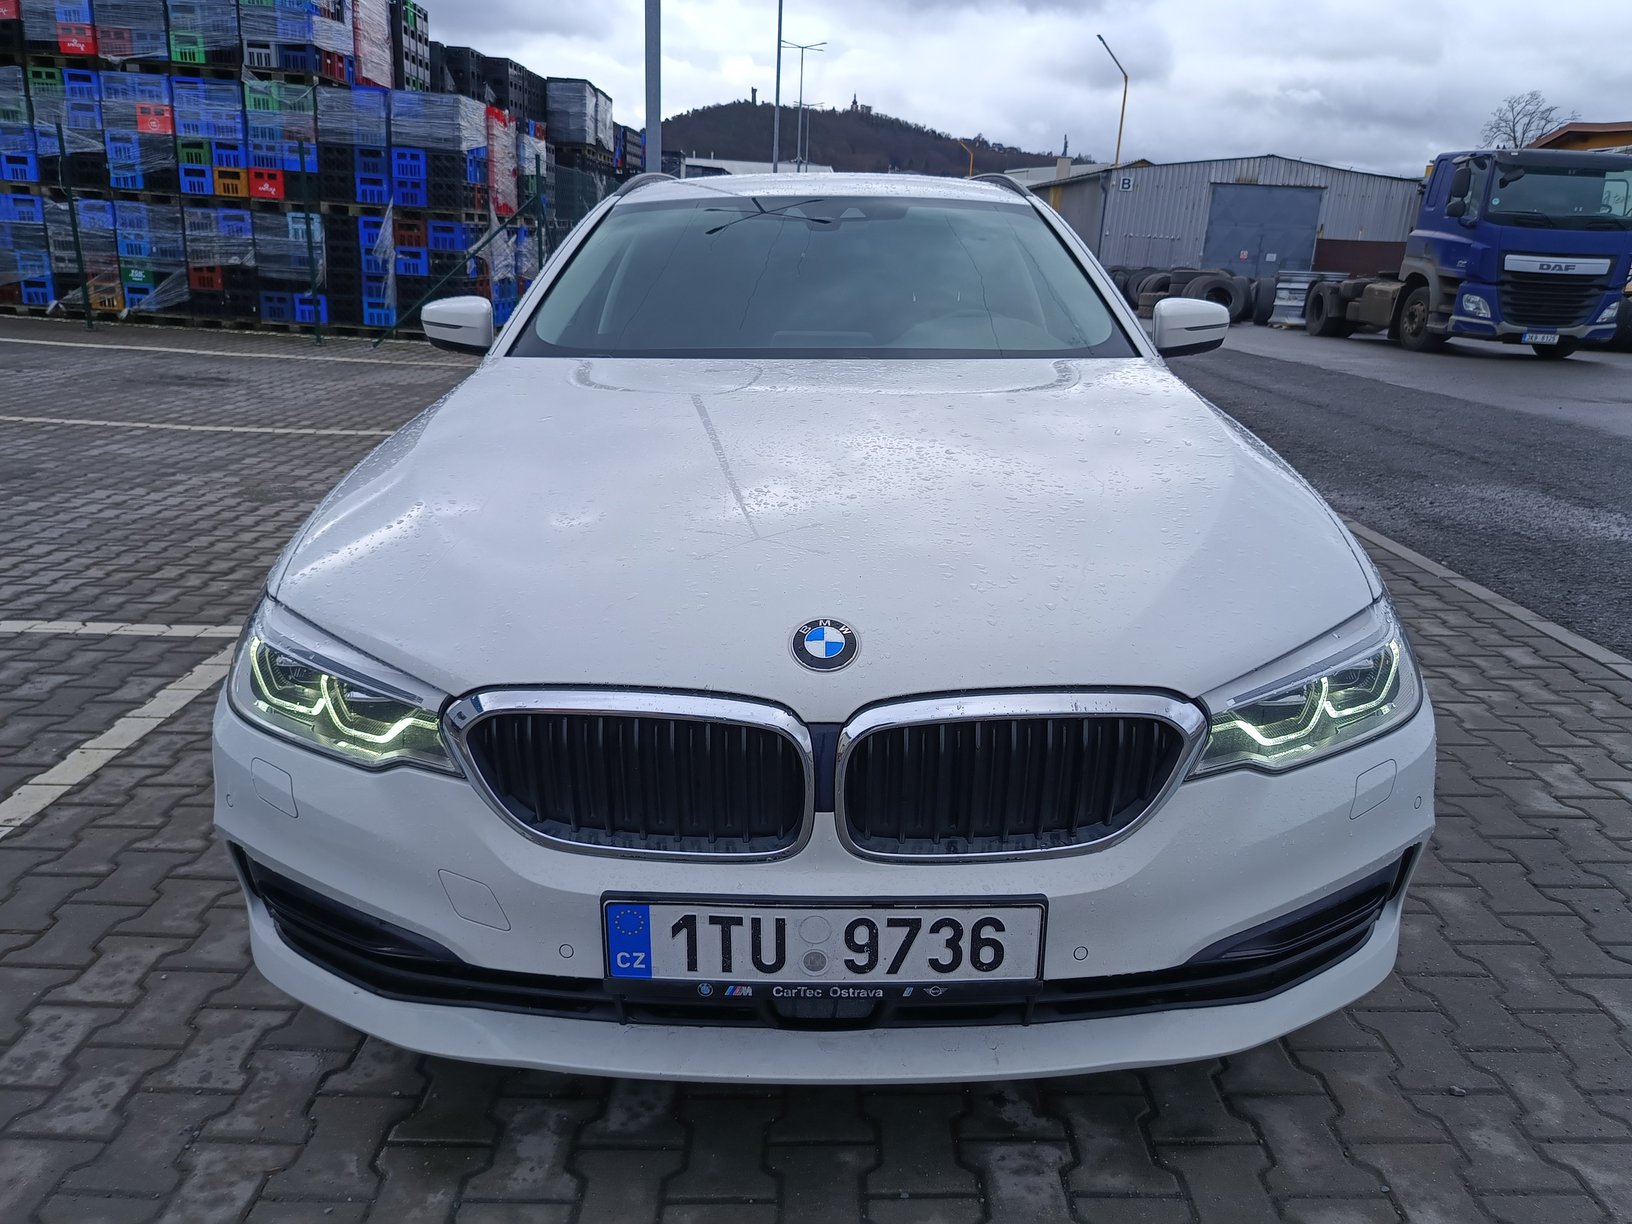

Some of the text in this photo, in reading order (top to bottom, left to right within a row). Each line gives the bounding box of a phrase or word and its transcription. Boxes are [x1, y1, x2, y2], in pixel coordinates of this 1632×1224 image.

[1121, 178, 1131, 190] B
[1538, 263, 1576, 272] DAF
[799, 620, 852, 634] BMW
[671, 914, 1006, 975] 1TU 9736
[616, 952, 646, 969] CZ
[772, 986, 884, 998] CarTec Ostrava
